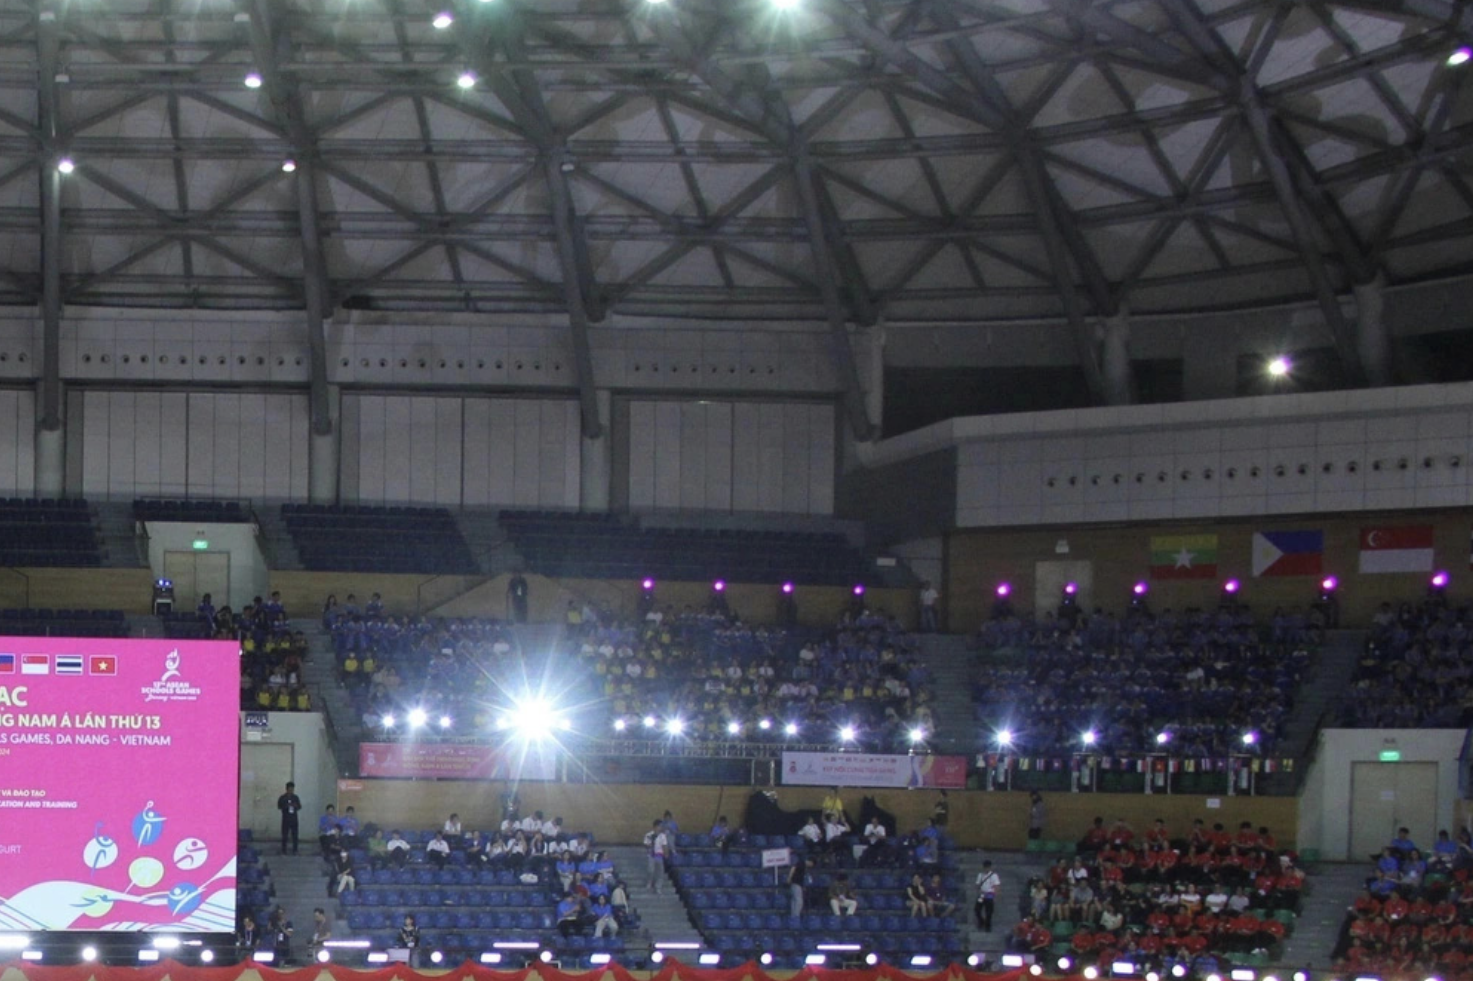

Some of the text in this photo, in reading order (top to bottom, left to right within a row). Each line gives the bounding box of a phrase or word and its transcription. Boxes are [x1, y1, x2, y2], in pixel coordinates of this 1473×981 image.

[18, 714, 57, 728] NAM
[60, 712, 72, 728] Á
[145, 716, 161, 729] 13
[10, 733, 54, 746] GAMES,
[56, 734, 73, 745] DA
[75, 734, 110, 745] NANG
[120, 735, 171, 746] VIETNAM
[42, 801, 78, 809] TRAINING
